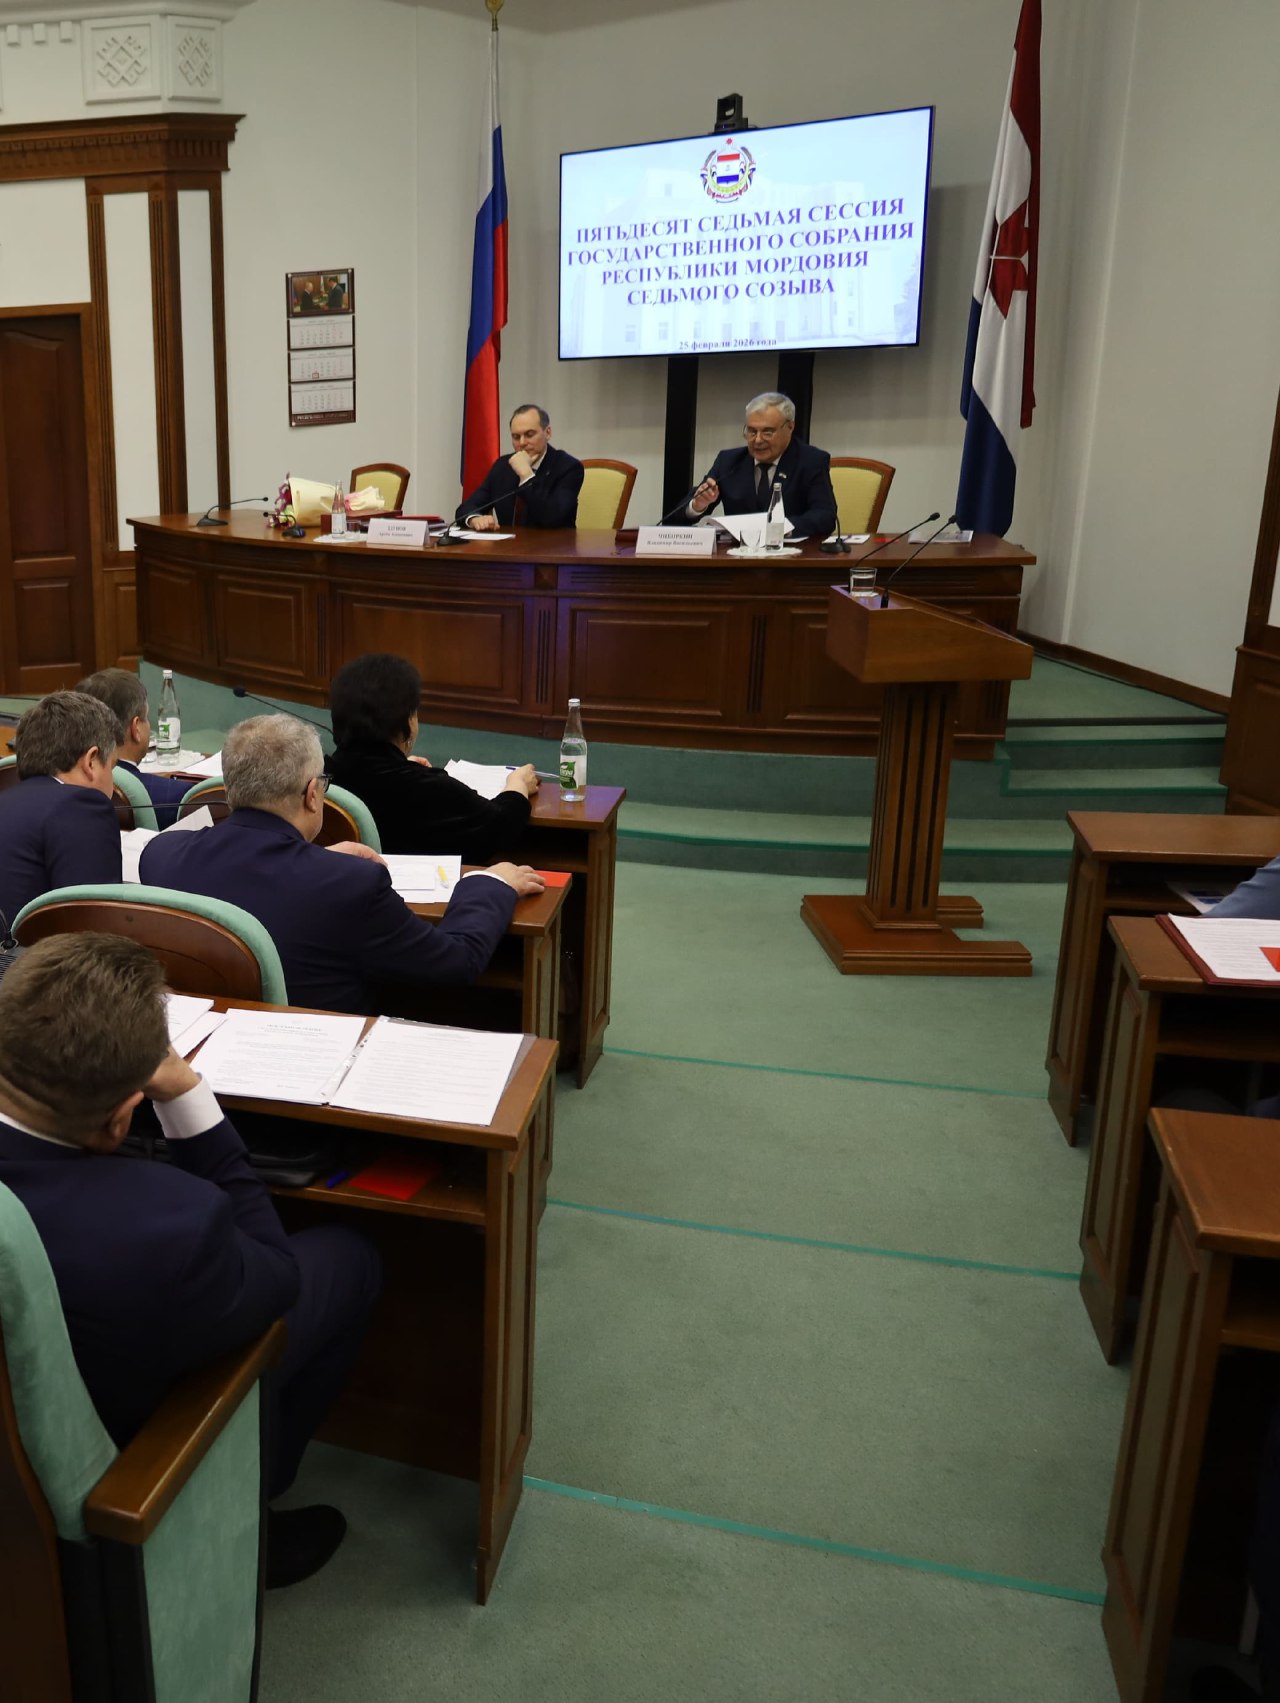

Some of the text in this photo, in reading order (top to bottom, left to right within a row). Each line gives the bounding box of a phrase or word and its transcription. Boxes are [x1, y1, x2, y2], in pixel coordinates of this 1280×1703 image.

[577, 198, 904, 243] ПЯТЬДЕСЯТ СЕДЬМАЯ СЕССИЯ
[568, 222, 914, 266] ГОСУДАРСТВЕННОГО СОБРАНИЯ
[603, 250, 868, 285] РЕСПУБЛИКИ МОРДОВИЯ
[627, 277, 835, 306] СЕДЬМОГО СОЗЫВА
[679, 339, 777, 351] 25 февраля 2026 года
